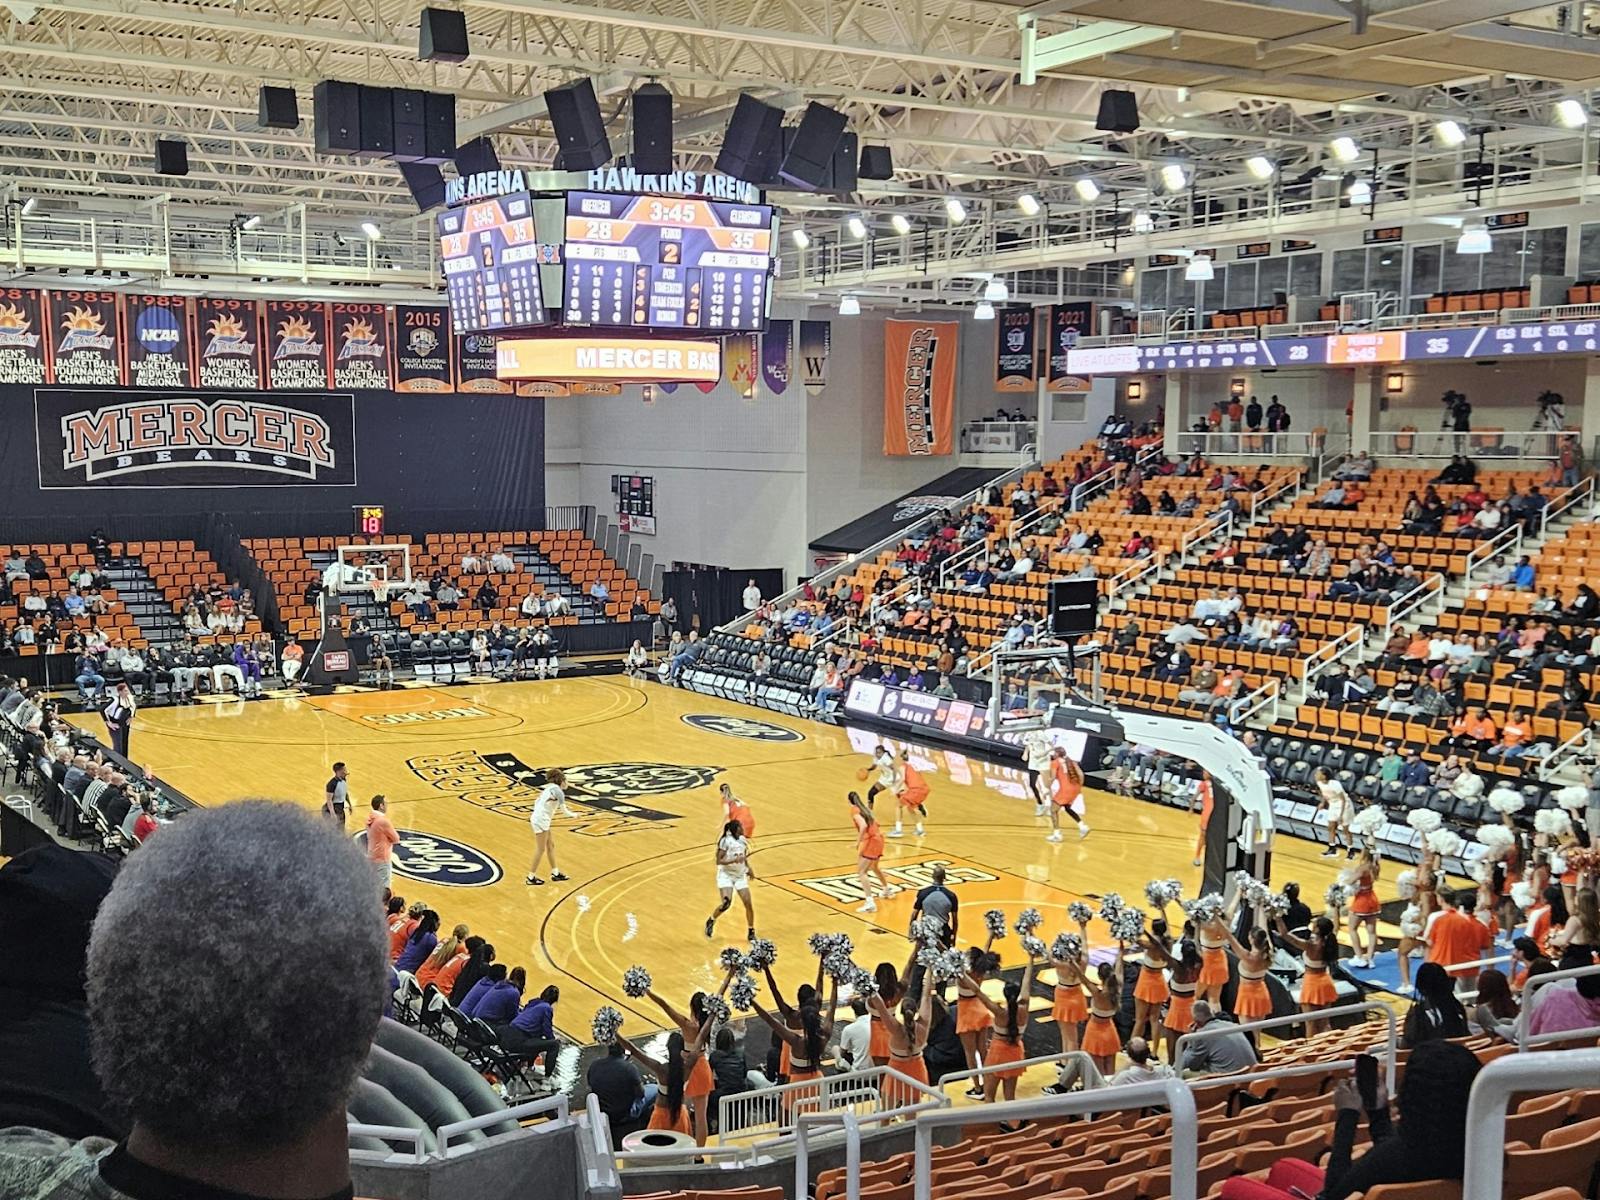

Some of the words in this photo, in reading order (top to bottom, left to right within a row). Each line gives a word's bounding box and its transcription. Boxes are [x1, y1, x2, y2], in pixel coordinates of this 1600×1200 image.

[468, 169, 525, 197] ARENA
[588, 167, 696, 193] HAWKINS
[703, 174, 753, 204] ARENA
[649, 201, 695, 222] 3:45
[586, 221, 612, 240] 28
[730, 232, 754, 249] 35
[663, 244, 678, 263] 2
[53, 291, 114, 303] 1985
[128, 296, 185, 307] 1985
[200, 299, 253, 310] 1991
[268, 302, 324, 312] 1992
[334, 304, 384, 314] 2003
[405, 312, 441, 326] 2015
[1057, 311, 1084, 325] 2021
[141, 329, 180, 342] NCAA
[1426, 338, 1449, 353] 35
[72, 351, 101, 360] MEN'S
[145, 354, 172, 362] MEN'S
[576, 347, 682, 368] MERCER
[56, 358, 116, 368] BASKETBALL
[130, 361, 188, 371] BASKETBALL
[206, 358, 251, 368] WOMEN'S
[276, 360, 319, 369] WOMEN'S
[347, 361, 374, 370] MEN'S
[805, 357, 825, 377] W
[53, 366, 120, 377] TOURNAMENT
[137, 370, 180, 379] MIDWEST
[200, 367, 258, 377] BASKETBALL
[270, 369, 327, 378] BASKETBALL
[334, 369, 389, 379] BASKETBALL
[766, 364, 788, 382] WCU
[58, 375, 117, 384] CHAMPIONS
[136, 378, 185, 387] REGIONAL
[201, 377, 257, 387] CHAMPIONS
[272, 378, 326, 388] CHAMPIONS
[335, 379, 387, 388] CHAMPIONS
[904, 328, 934, 456] MERCER
[64, 400, 334, 468] MERCER
[117, 450, 288, 467] BEARS
[362, 517, 379, 533] 18
